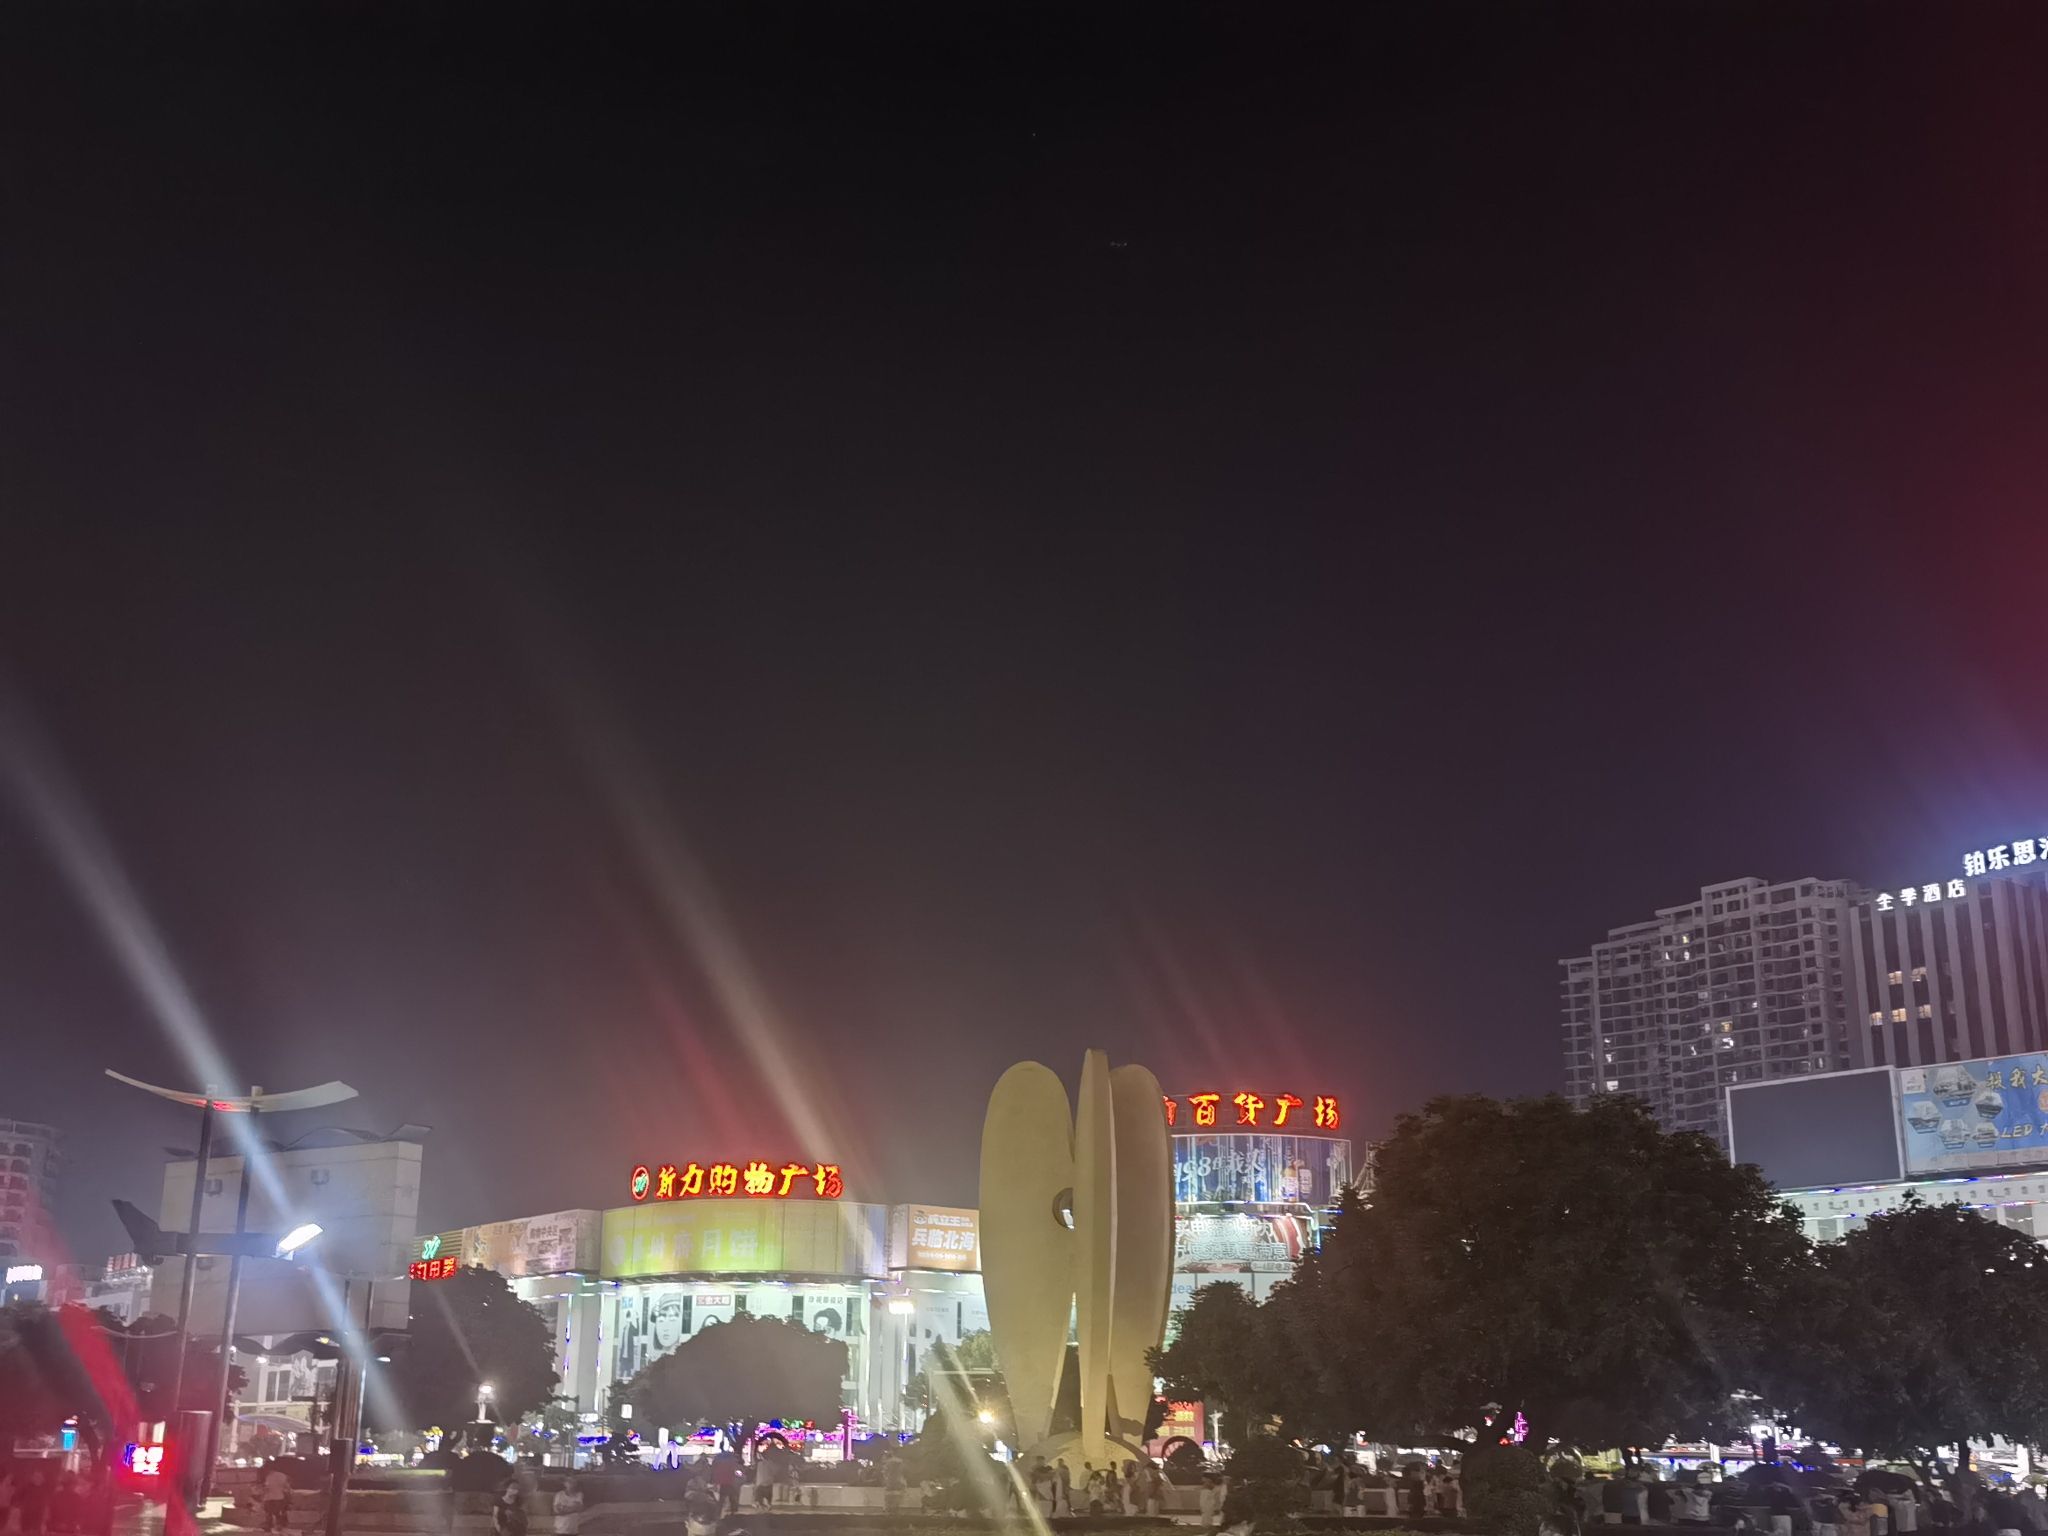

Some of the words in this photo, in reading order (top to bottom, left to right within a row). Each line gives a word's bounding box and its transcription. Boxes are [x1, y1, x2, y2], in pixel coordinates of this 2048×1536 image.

[1875, 878, 1967, 912] 全季酒店
[2000, 1123, 2033, 1138] LED
[657, 1162, 844, 1199] 新力购物广场
[911, 1228, 976, 1252] 兵临北海
